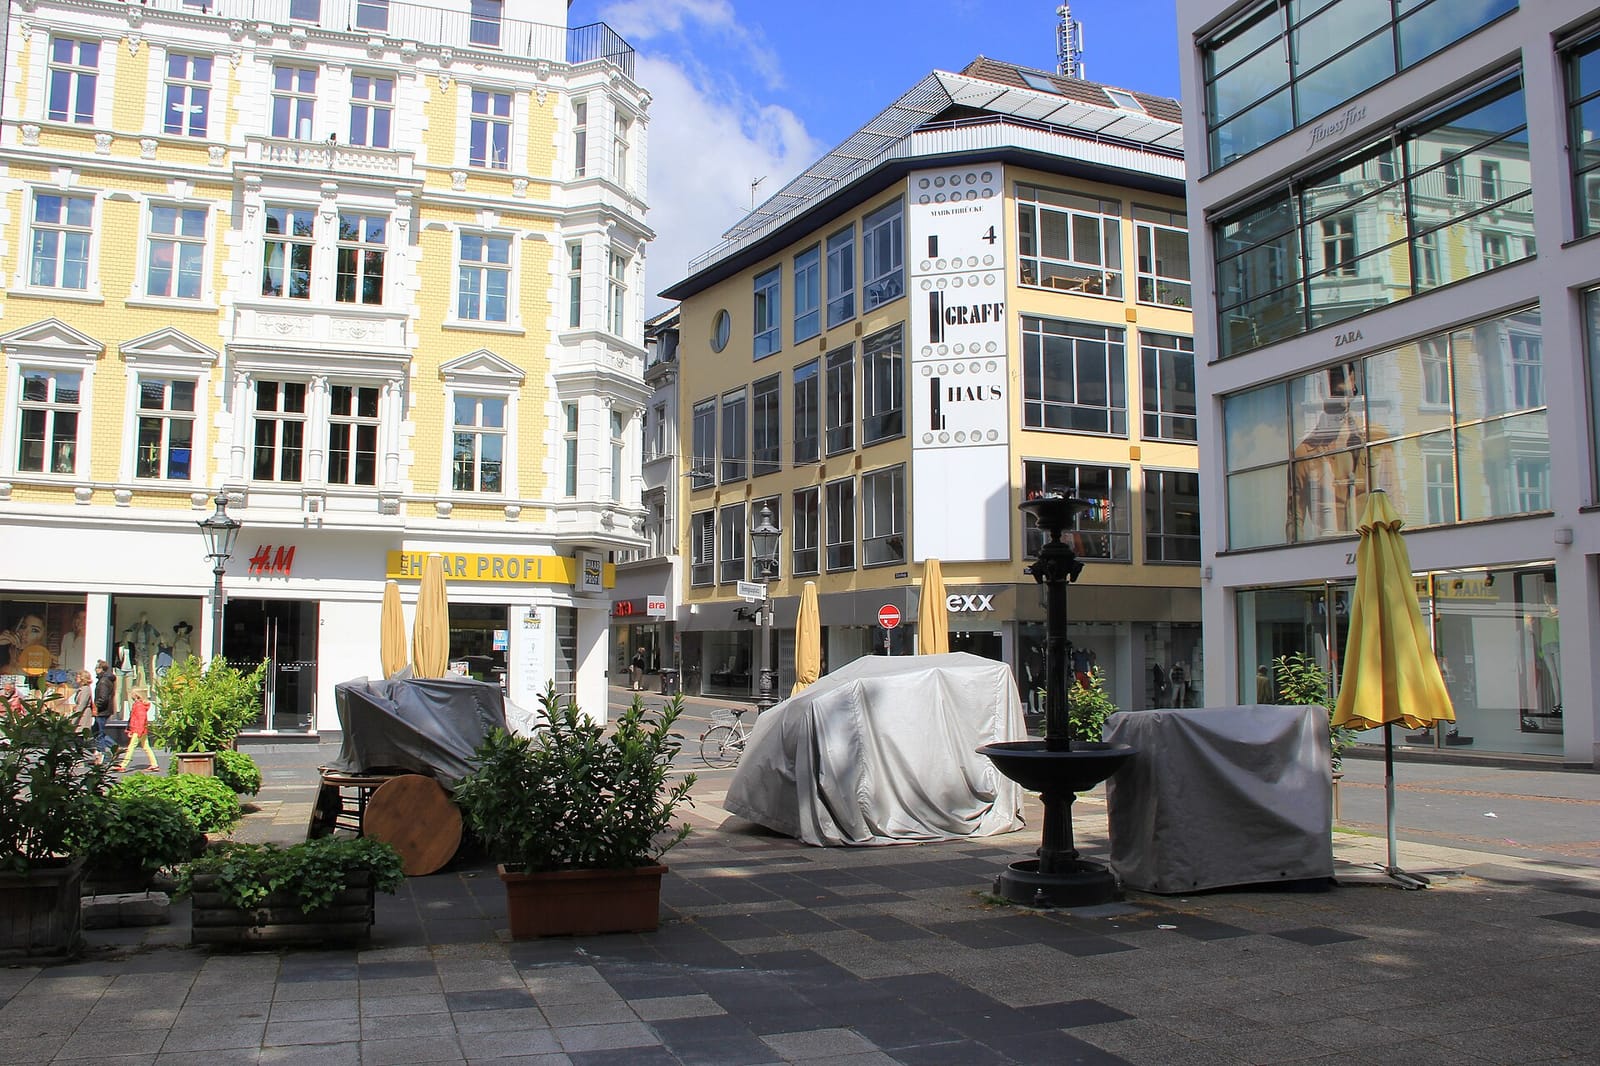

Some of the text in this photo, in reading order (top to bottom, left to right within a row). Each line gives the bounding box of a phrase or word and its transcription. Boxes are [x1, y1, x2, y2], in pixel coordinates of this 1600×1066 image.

[982, 225, 997, 245] 4
[945, 303, 1004, 326] GRAFF
[1334, 329, 1363, 347] ZARA
[948, 385, 1002, 402] HAUS
[248, 544, 296, 576] H&M
[410, 554, 542, 580] HAR PROFI
[648, 601, 666, 609] ara
[946, 594, 995, 613] exx
[319, 618, 325, 626] 2
